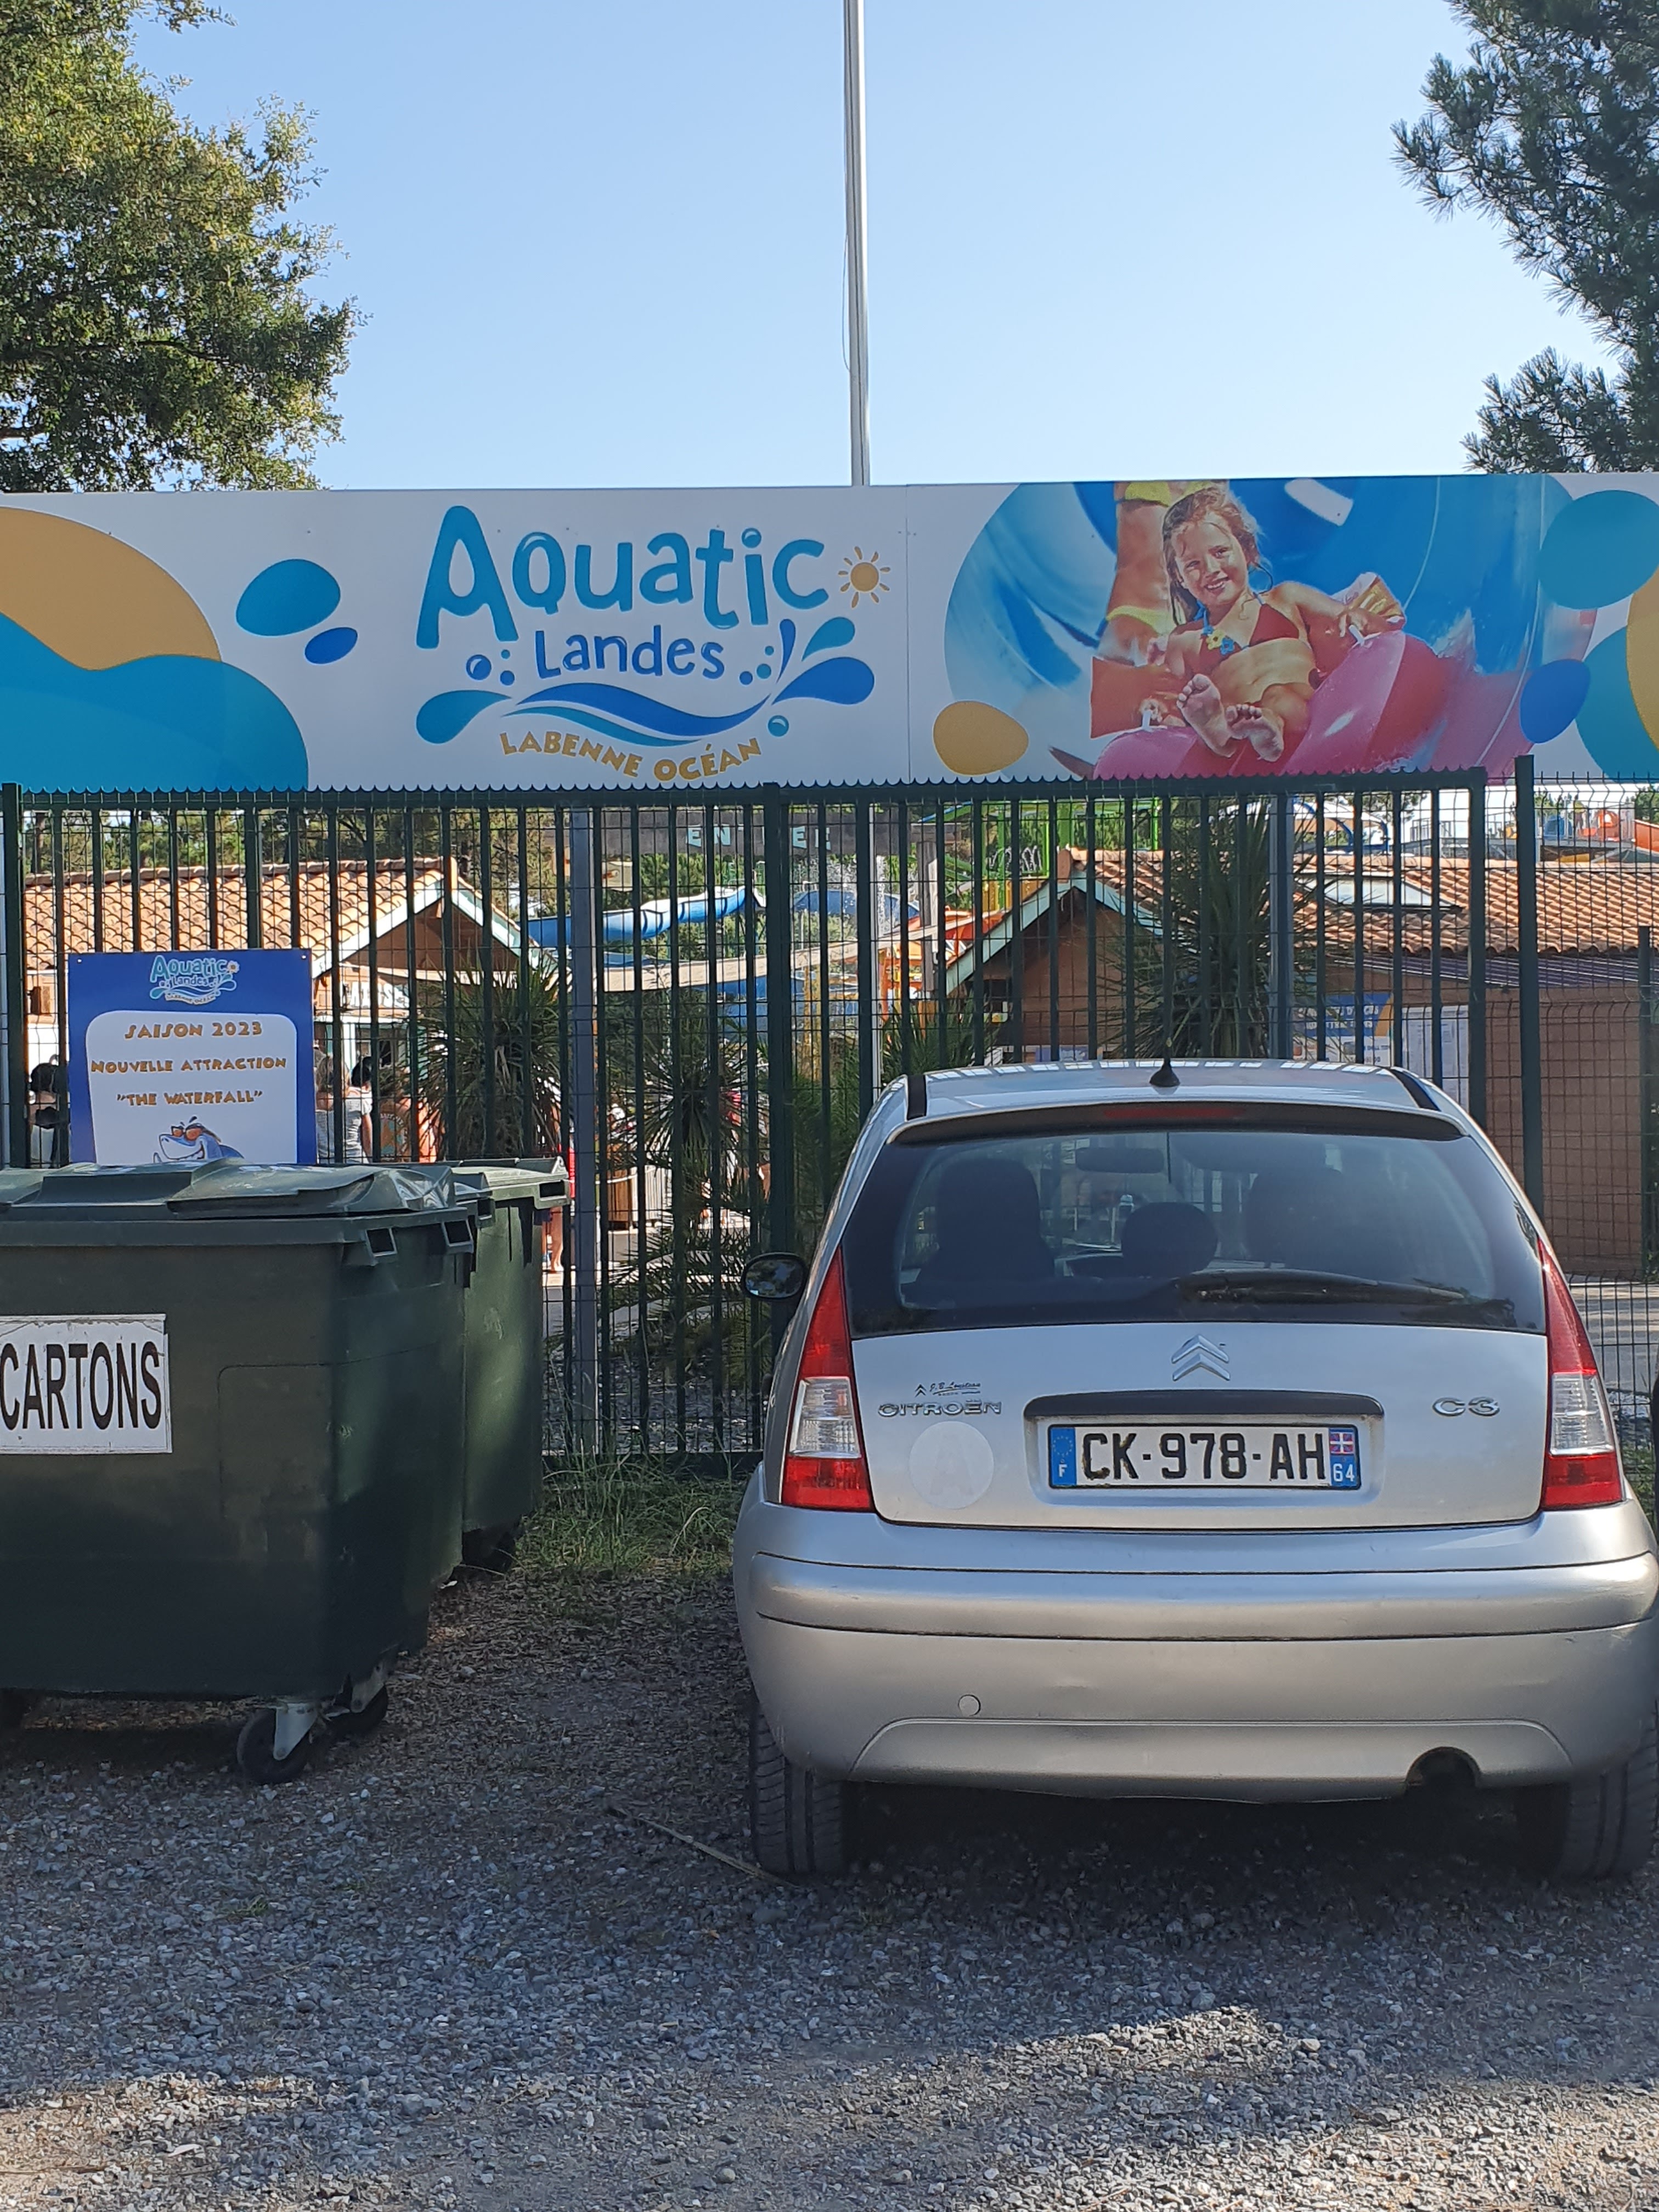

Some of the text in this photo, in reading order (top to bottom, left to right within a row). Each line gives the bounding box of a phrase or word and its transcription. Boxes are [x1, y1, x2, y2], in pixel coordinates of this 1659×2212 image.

[416, 505, 828, 649] Aquatic
[535, 624, 726, 680] Landes
[500, 731, 763, 782] LABENNE OCÉAN
[150, 955, 228, 983] Aquatic
[171, 974, 209, 986] Landes
[125, 1021, 262, 1040] SAISON 2023
[91, 1057, 287, 1074] NOUVELLE ATTRACTION
[0, 1341, 162, 1430] CARTONS
[1432, 1397, 1500, 1417] C3
[1058, 1464, 1068, 1478] F
[1333, 1463, 1356, 1483] 64
